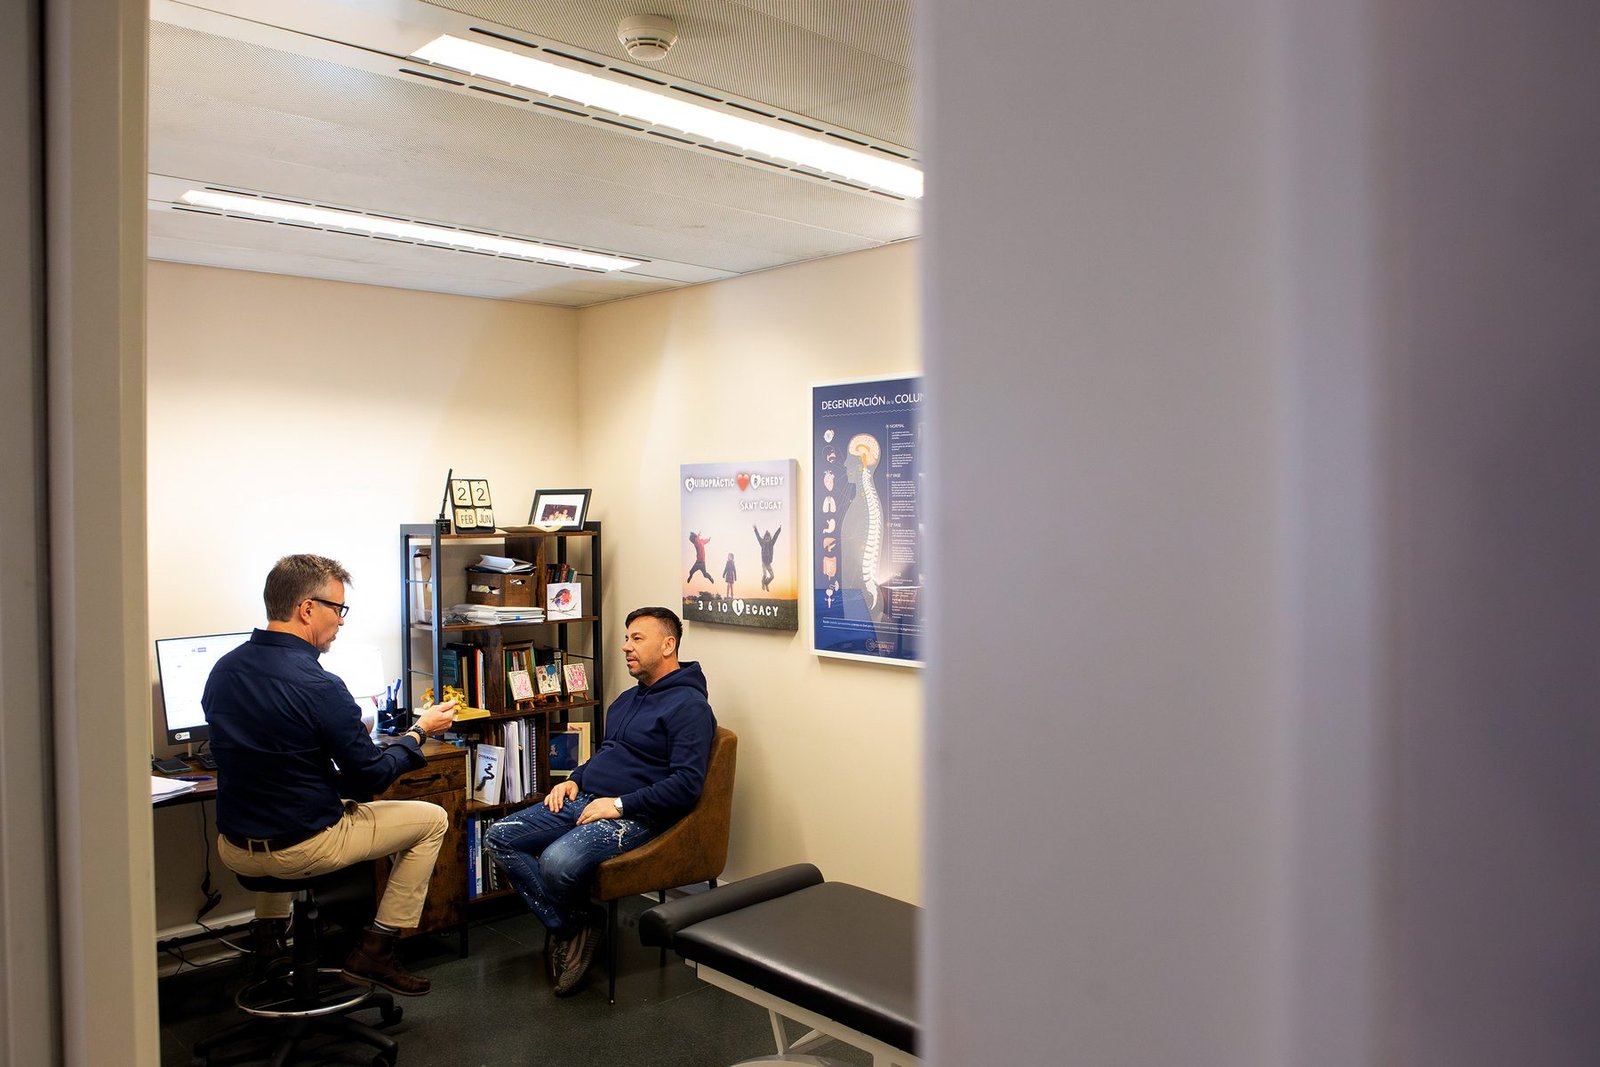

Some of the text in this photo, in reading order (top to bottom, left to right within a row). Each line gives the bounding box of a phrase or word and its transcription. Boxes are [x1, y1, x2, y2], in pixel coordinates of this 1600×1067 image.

[821, 394, 886, 410] DEGENERACIÓN
[457, 487, 486, 502] 2 2
[740, 500, 781, 510] SANT CUGAT
[461, 514, 492, 524] FEB JUN
[698, 600, 779, 616] 3 6 10 LEGACY
